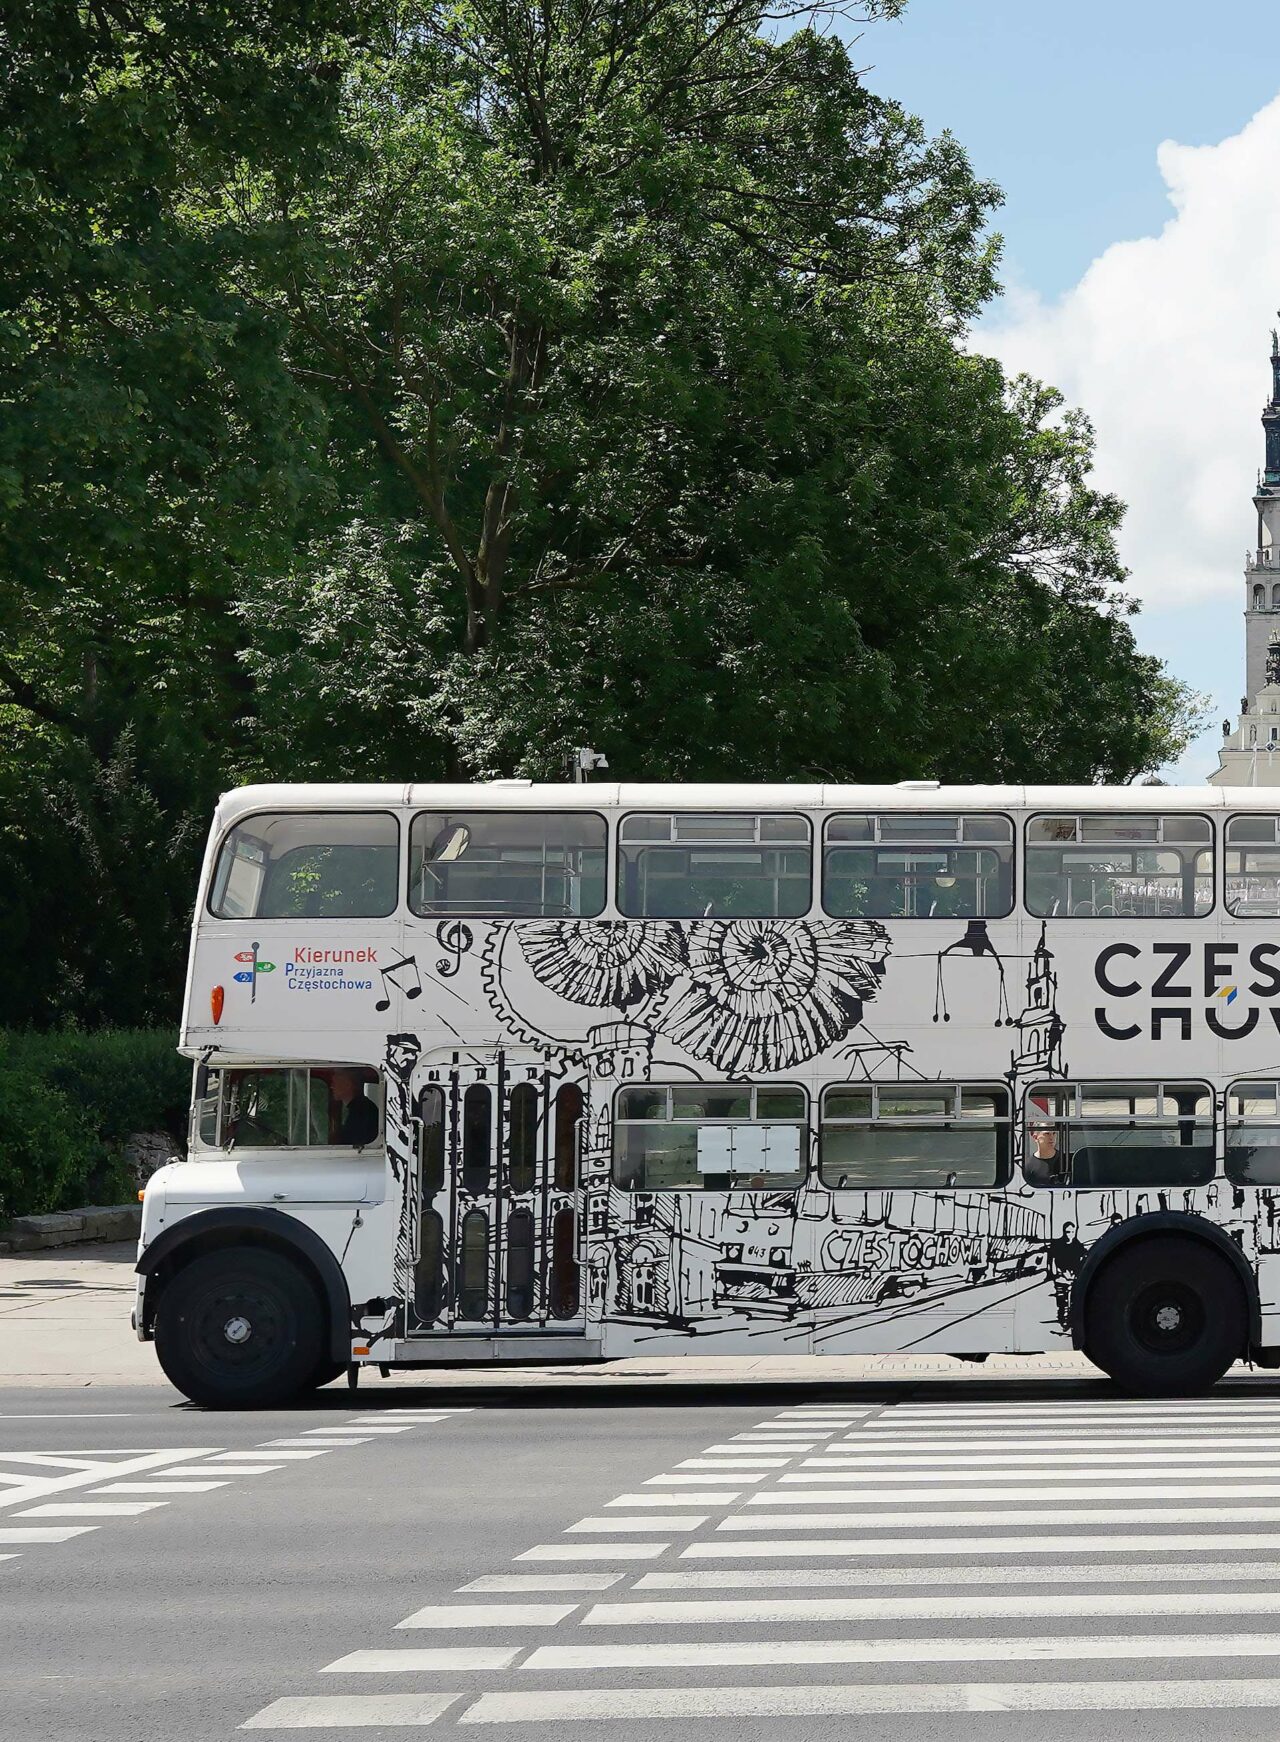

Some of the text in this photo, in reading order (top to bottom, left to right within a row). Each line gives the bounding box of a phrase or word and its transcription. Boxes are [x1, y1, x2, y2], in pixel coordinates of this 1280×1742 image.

[294, 947, 378, 963] Kierunek
[285, 962, 344, 977] Przyjazna
[288, 977, 372, 992] Częstochowa
